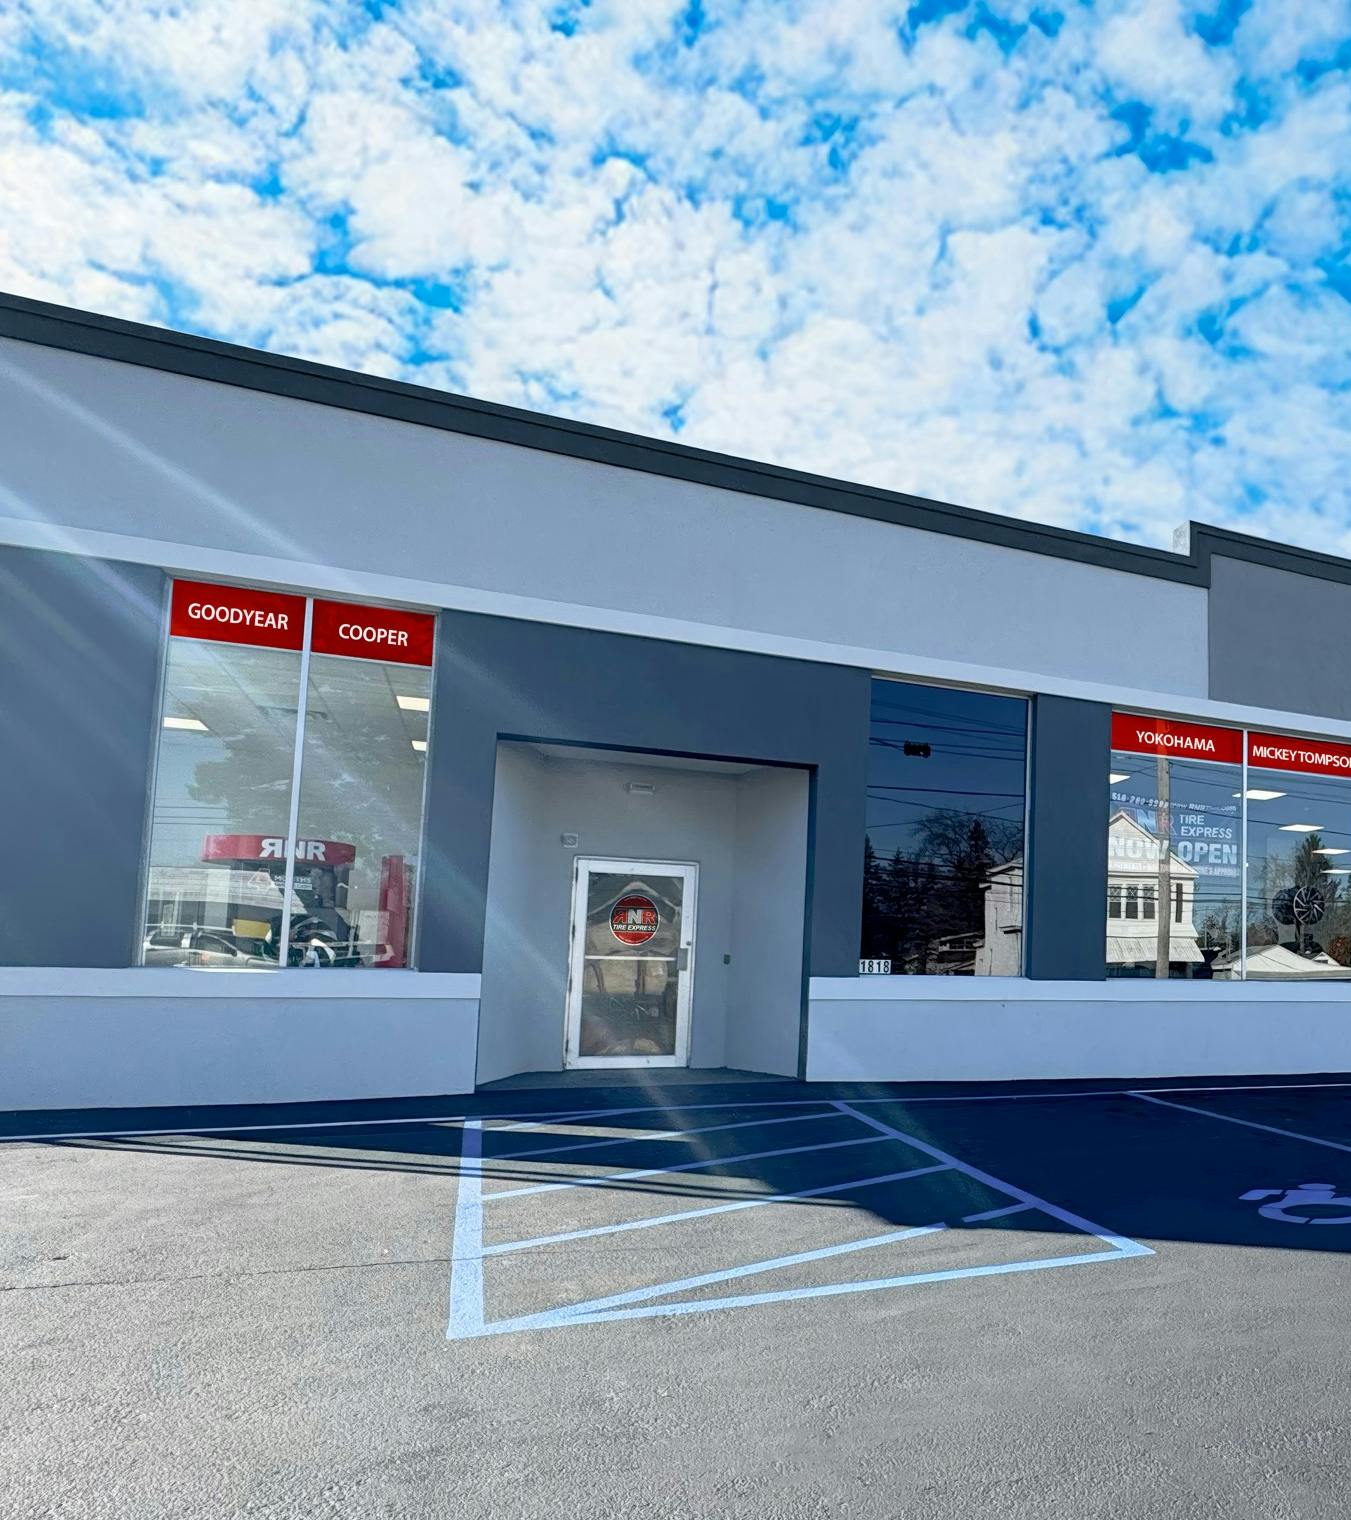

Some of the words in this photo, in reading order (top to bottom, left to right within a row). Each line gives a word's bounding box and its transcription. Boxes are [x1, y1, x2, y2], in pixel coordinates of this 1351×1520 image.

[187, 603, 289, 630] GOODYEAR
[338, 623, 408, 647] COOPER
[1136, 730, 1216, 752] YOKOHAMA
[1179, 814, 1205, 825] TIRE
[1180, 826, 1233, 839] EXPRESS
[1177, 841, 1238, 865] OPEN
[861, 960, 889, 972] 1818
